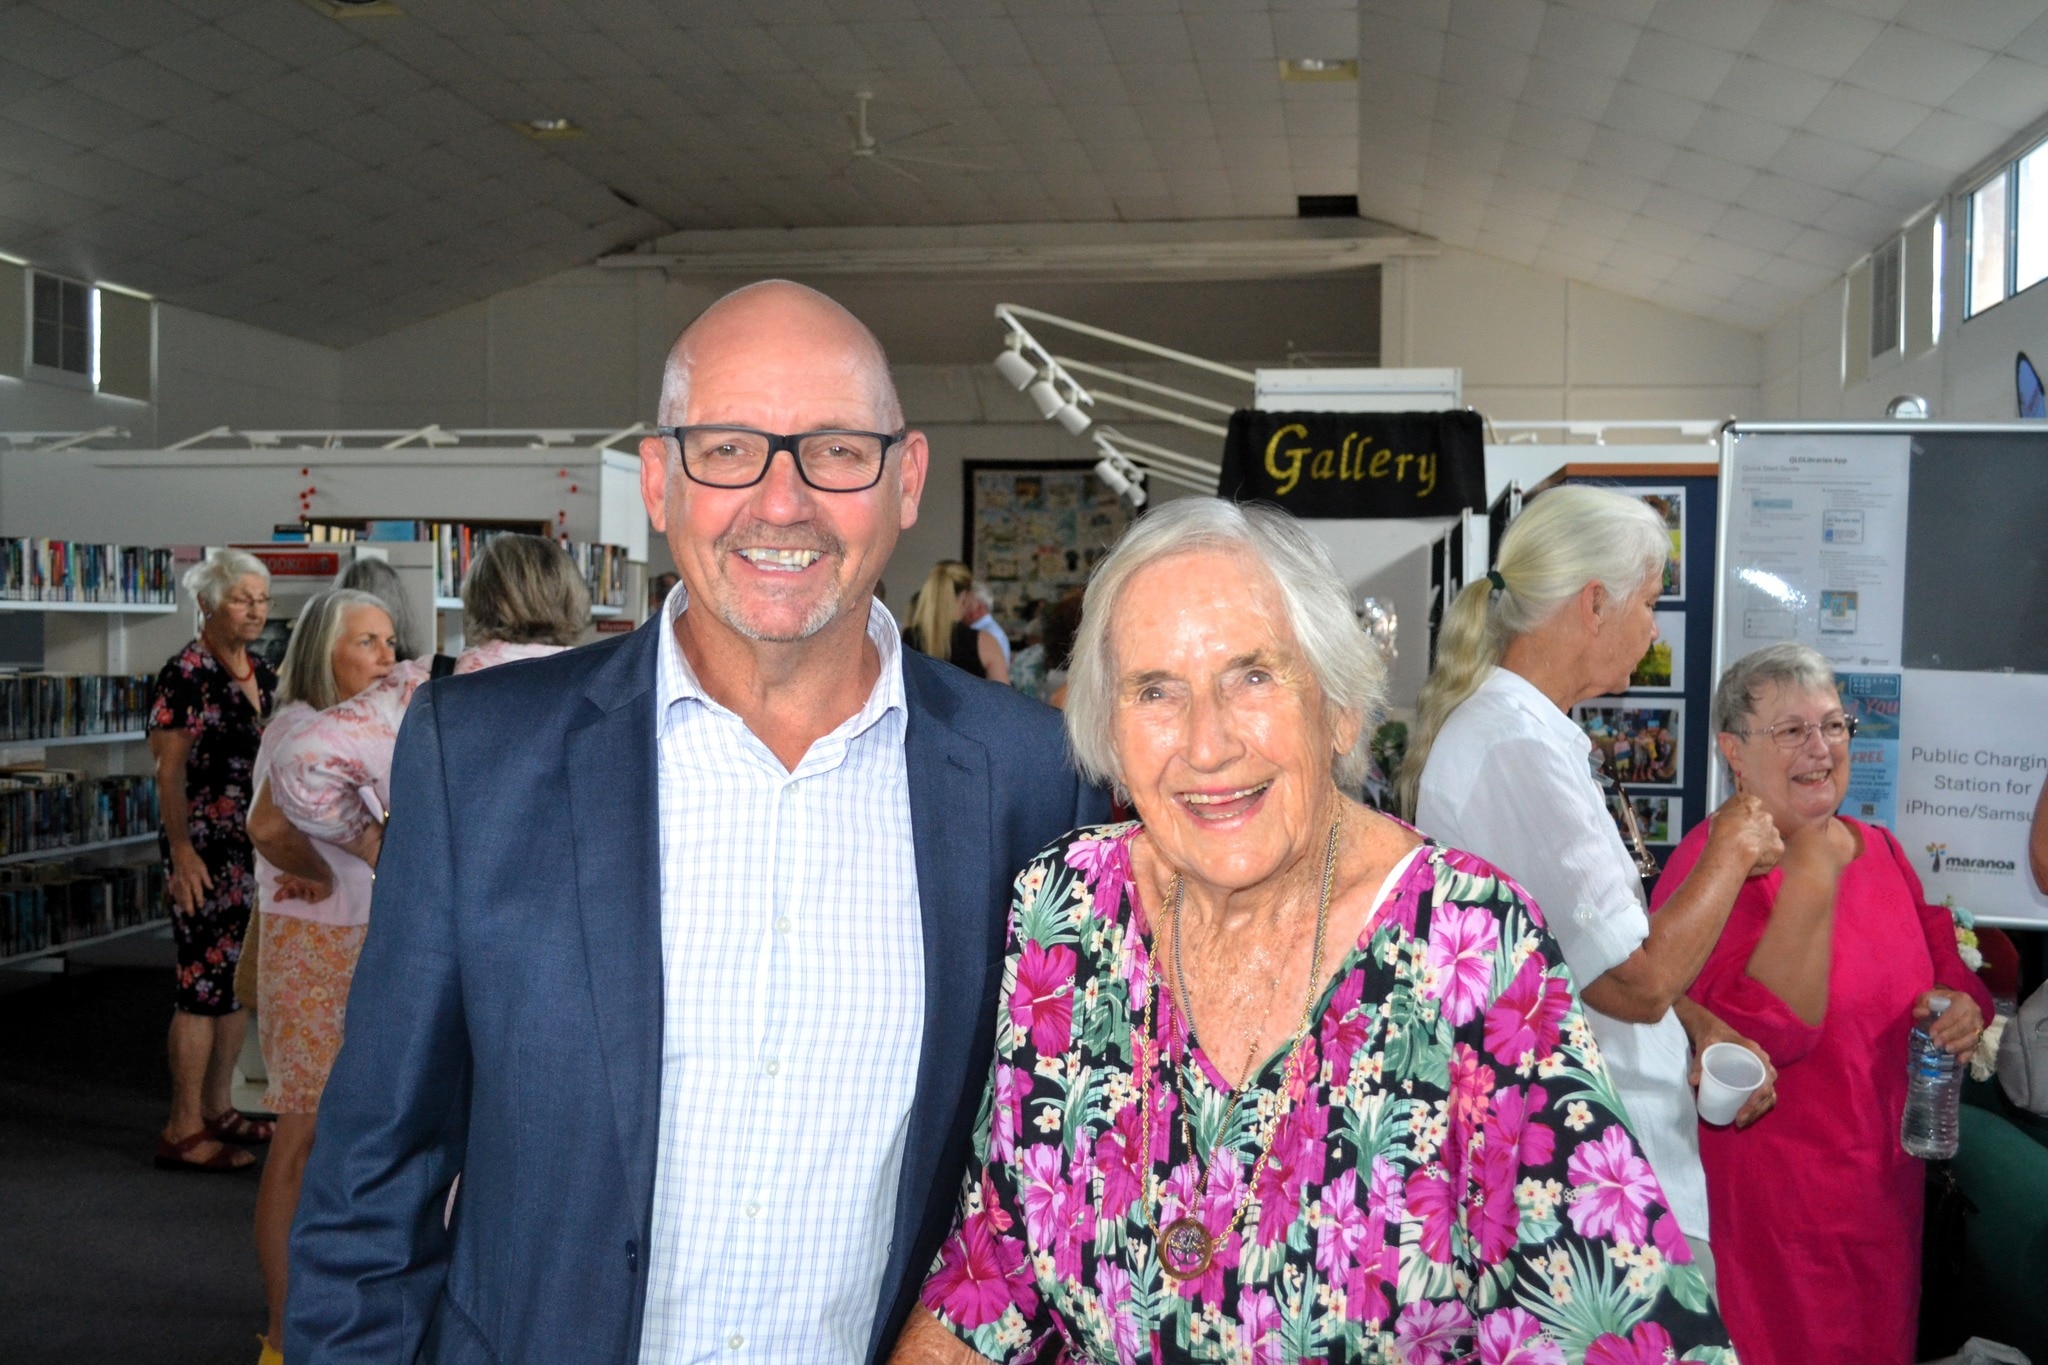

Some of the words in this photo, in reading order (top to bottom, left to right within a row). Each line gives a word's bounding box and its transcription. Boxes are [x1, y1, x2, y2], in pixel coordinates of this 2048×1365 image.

[1264, 423, 1437, 497] Gallery
[1834, 456, 1848, 465] App
[1851, 750, 1884, 763] FREE
[1911, 746, 1969, 765] Public
[1974, 750, 2048, 772] Chargin
[1934, 774, 2001, 793] Station
[2006, 779, 2032, 795] for
[1905, 800, 2034, 823] iPhone/Samsu
[1945, 857, 2015, 871] maranoa
